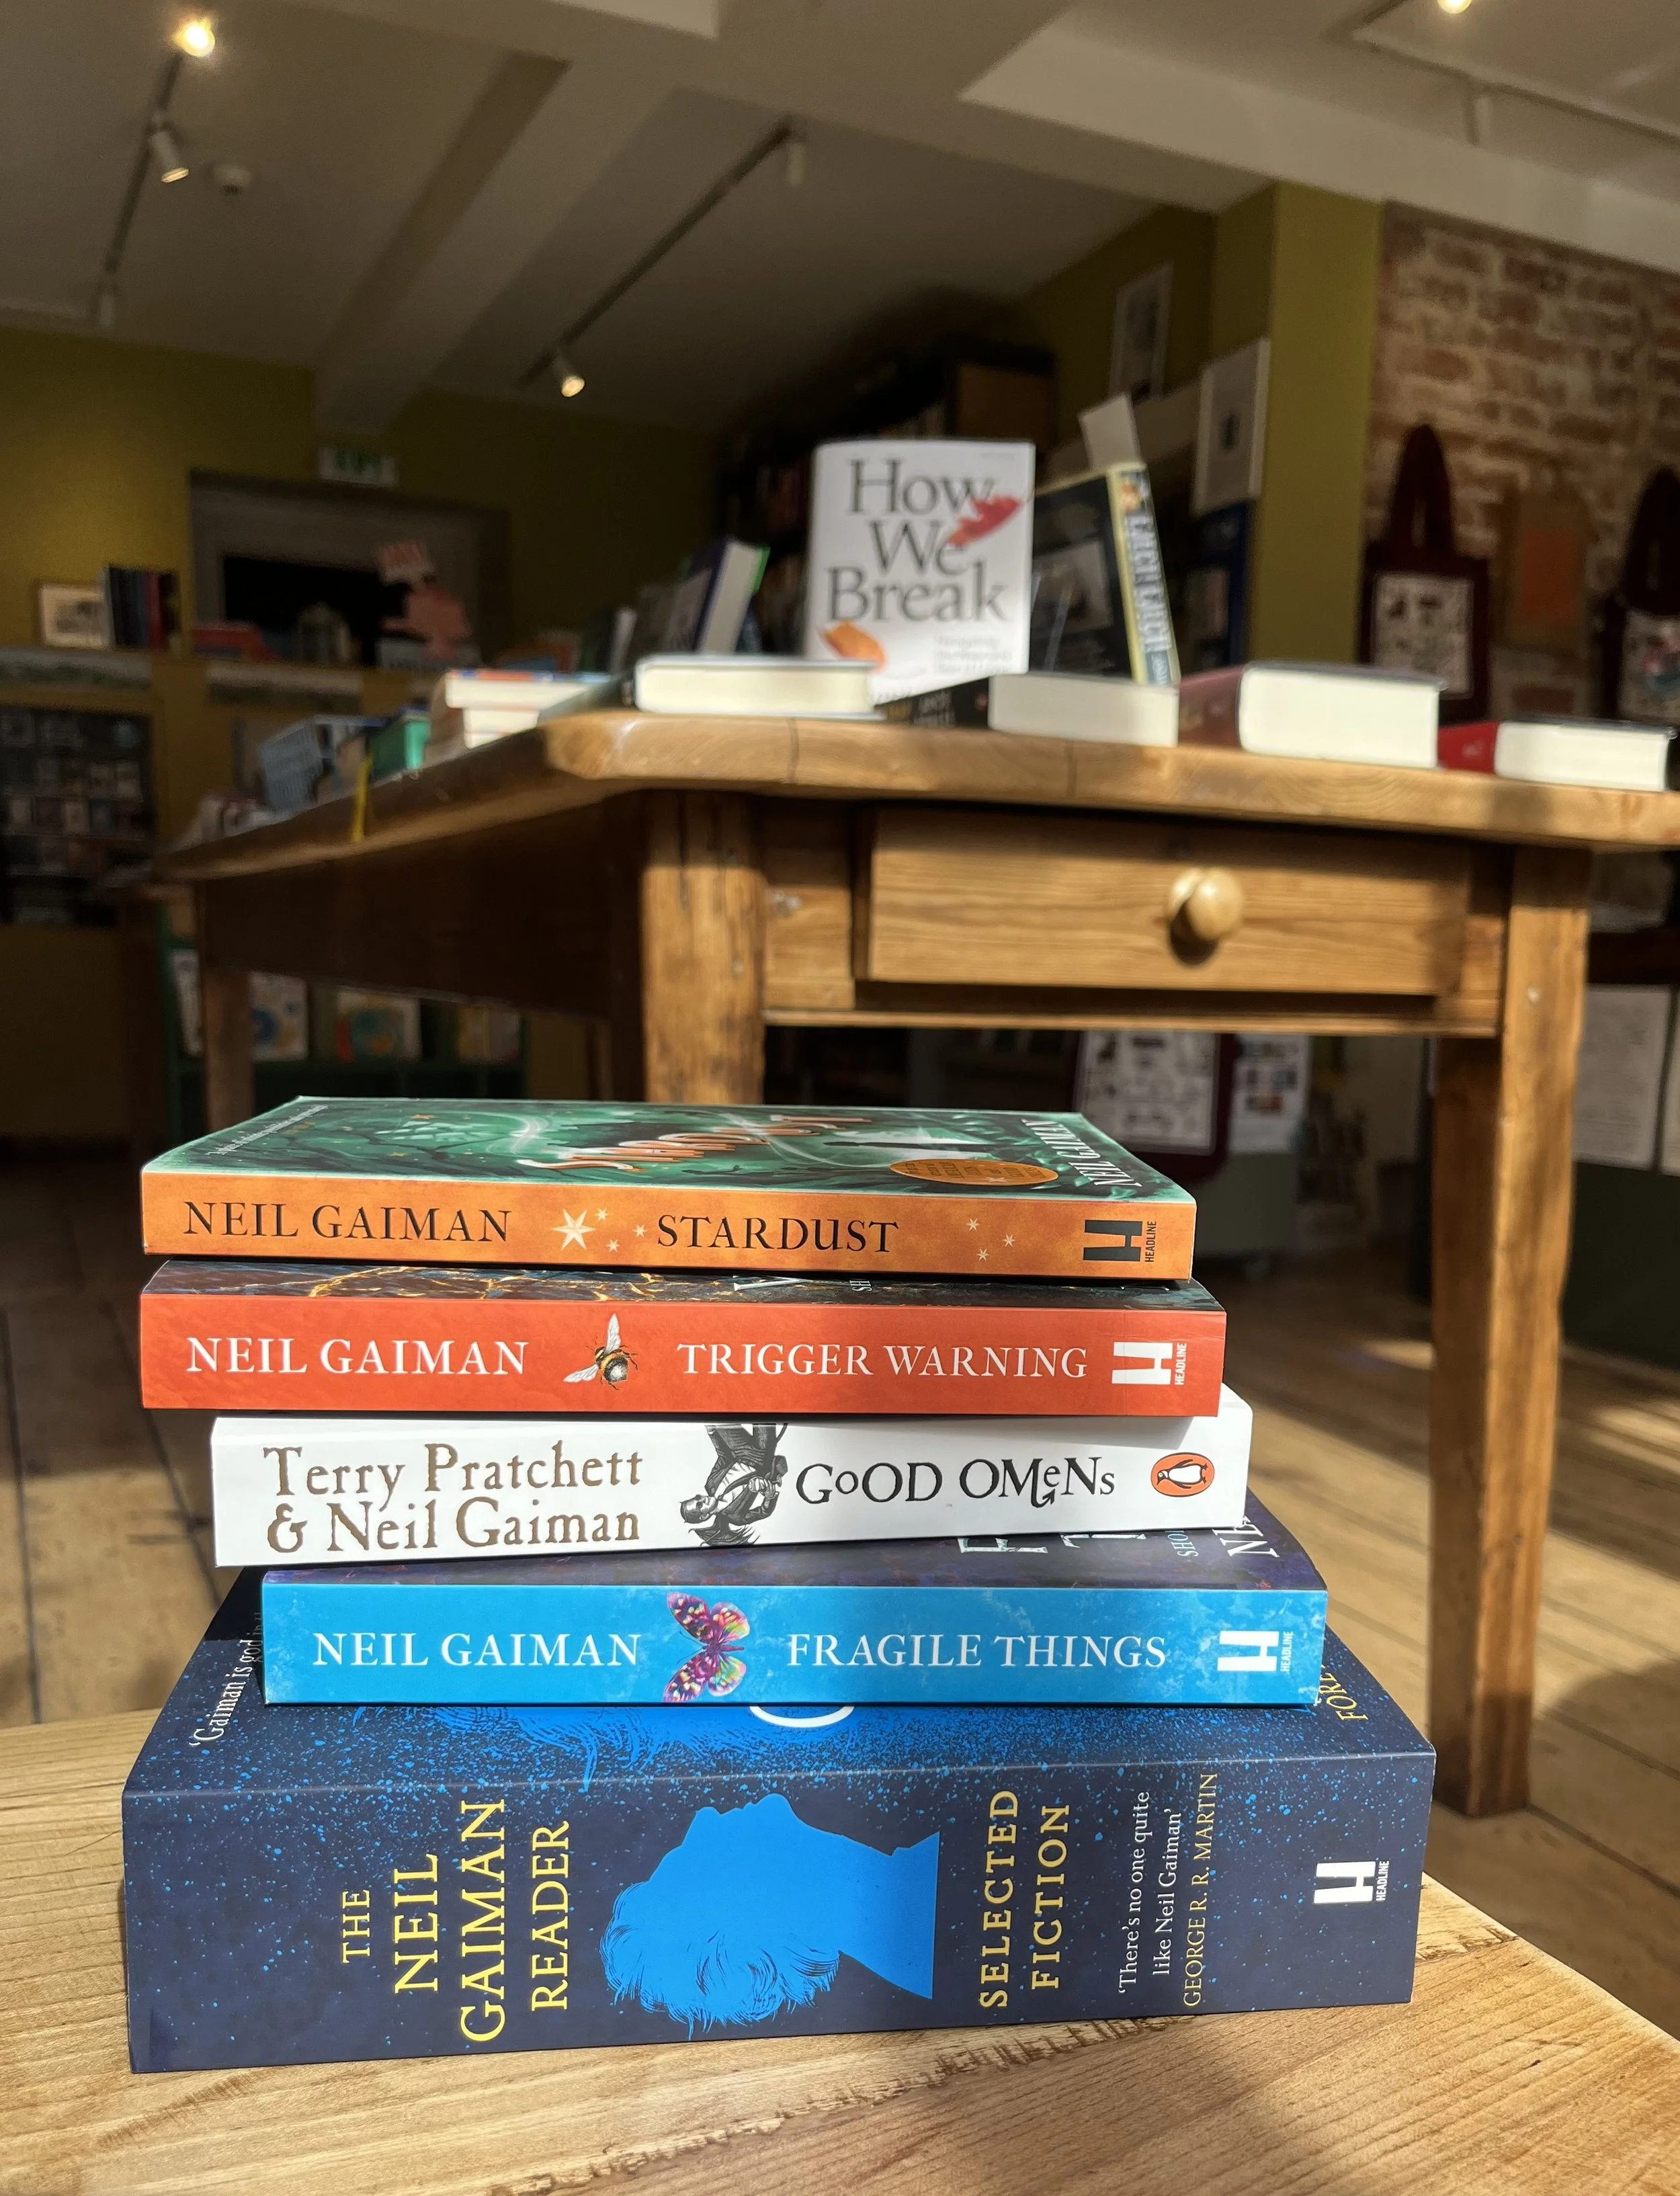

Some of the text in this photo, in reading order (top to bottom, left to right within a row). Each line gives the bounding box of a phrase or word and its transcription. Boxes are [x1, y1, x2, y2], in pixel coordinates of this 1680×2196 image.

[849, 459, 995, 515] How
[869, 520, 969, 576] We
[827, 560, 1008, 621] Break
[1021, 1118, 1101, 1158] GAIMAN
[1068, 1160, 1142, 1187] NEIL
[183, 1201, 899, 1254] NEIL GAIMAN STARDUST
[1144, 1220, 1157, 1263] HEADLINE
[186, 1337, 1088, 1379] NEIL GAIMAN TRIGGER WARNING
[1174, 1342, 1187, 1386] HEADLINE
[263, 1440, 642, 1511] Terry Pratchett
[267, 1496, 640, 1554] & Neil Gaiman
[313, 1632, 1167, 1669] NEIL GAIMAN FRAGILE THINGS
[1279, 1630, 1294, 1673] HEADLINE
[189, 1681, 247, 1746] 'Gaiman
[225, 1666, 253, 1678] is
[239, 1639, 263, 1663] god
[979, 1790, 1019, 2008] SELECTED
[1031, 1805, 1070, 1990] FICTION
[1118, 1791, 1152, 1994] 'There's no one quite
[1152, 1808, 1182, 1976] like Neil Gaiman'
[1183, 1773, 1218, 2007] GEORGE R. R. MARTIN
[1375, 1860, 1390, 1903] HEADLINE
[342, 1889, 370, 1963] THE
[394, 1853, 439, 1994] NEIL
[460, 1799, 505, 2042] GAIMAN
[532, 1820, 570, 2011] READER
